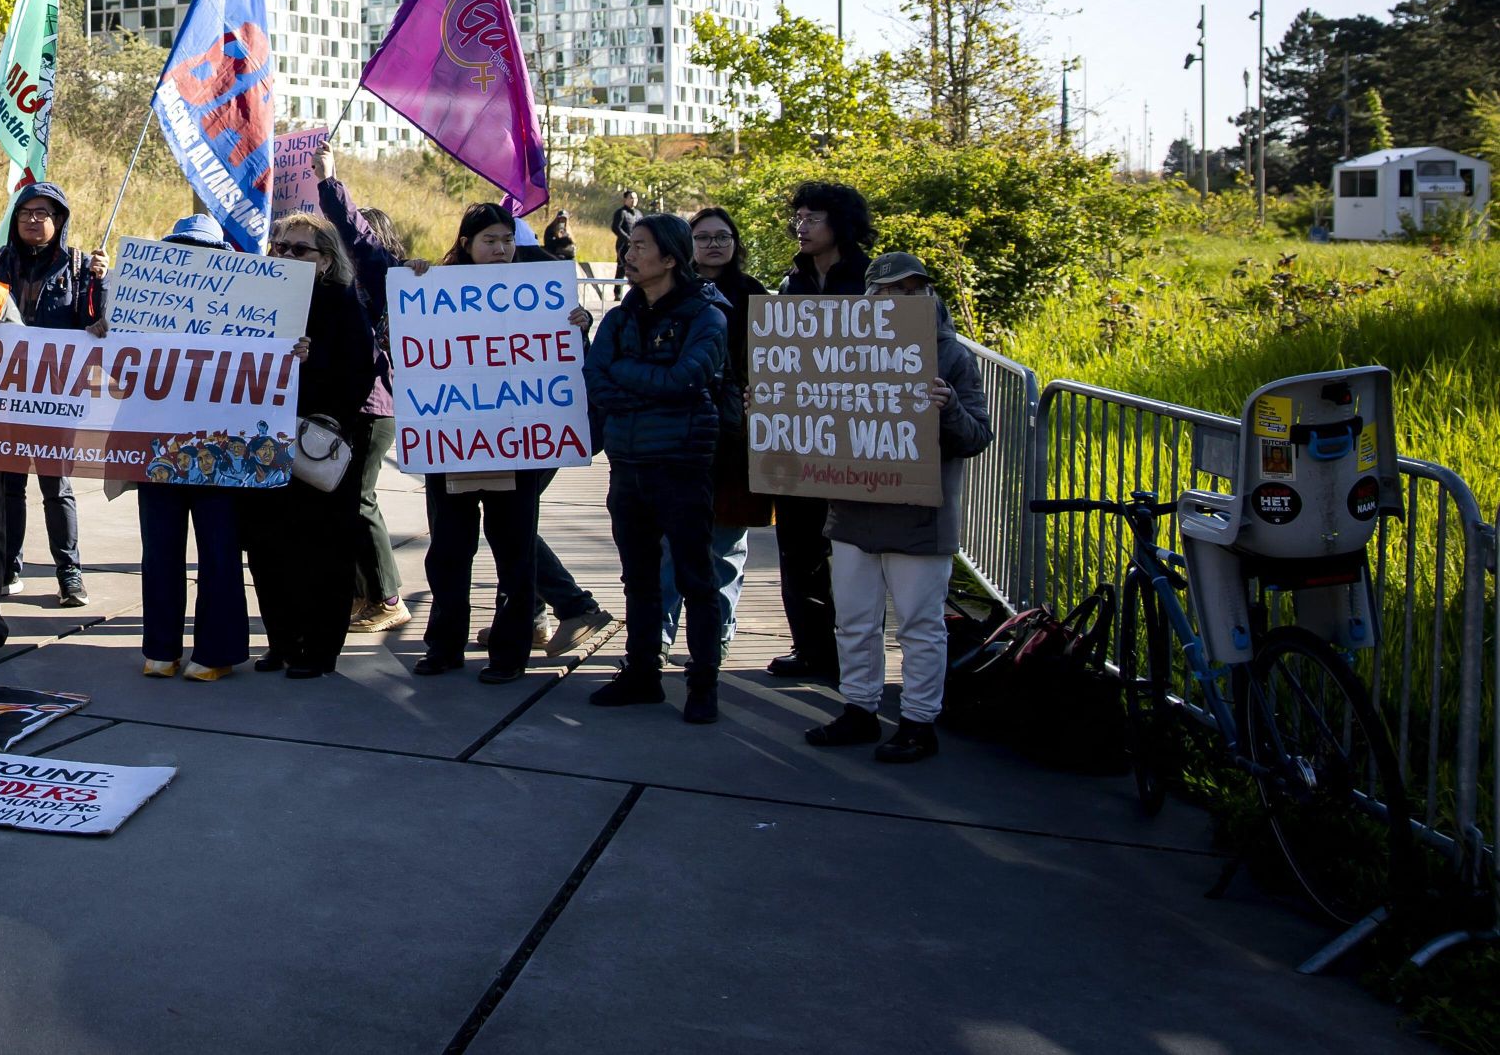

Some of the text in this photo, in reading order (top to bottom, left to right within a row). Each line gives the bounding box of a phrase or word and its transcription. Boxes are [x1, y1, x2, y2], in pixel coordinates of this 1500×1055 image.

[156, 78, 269, 238] BAGONG ALYANSANG
[302, 168, 311, 180] is
[122, 243, 193, 267] DUTERTE
[119, 262, 235, 297] PANAGUTIN!
[115, 284, 278, 326] HUSTISYA SA MGA
[400, 280, 565, 315] MARCOS
[110, 306, 177, 329] BIKTIMA
[185, 319, 211, 335] NG
[752, 299, 895, 339] JUSTICE
[402, 330, 577, 370] DUTERTE
[752, 344, 922, 374] FOR VICTIMS
[9, 398, 85, 418] HANDEN!
[407, 375, 574, 416] WALANG
[755, 381, 931, 413] OF DUTERTE'S
[750, 413, 919, 460] DRUG WAR
[14, 443, 147, 466] PAMAMASLANG!
[801, 462, 902, 492] Makabayan
[1260, 496, 1291, 507] HET
